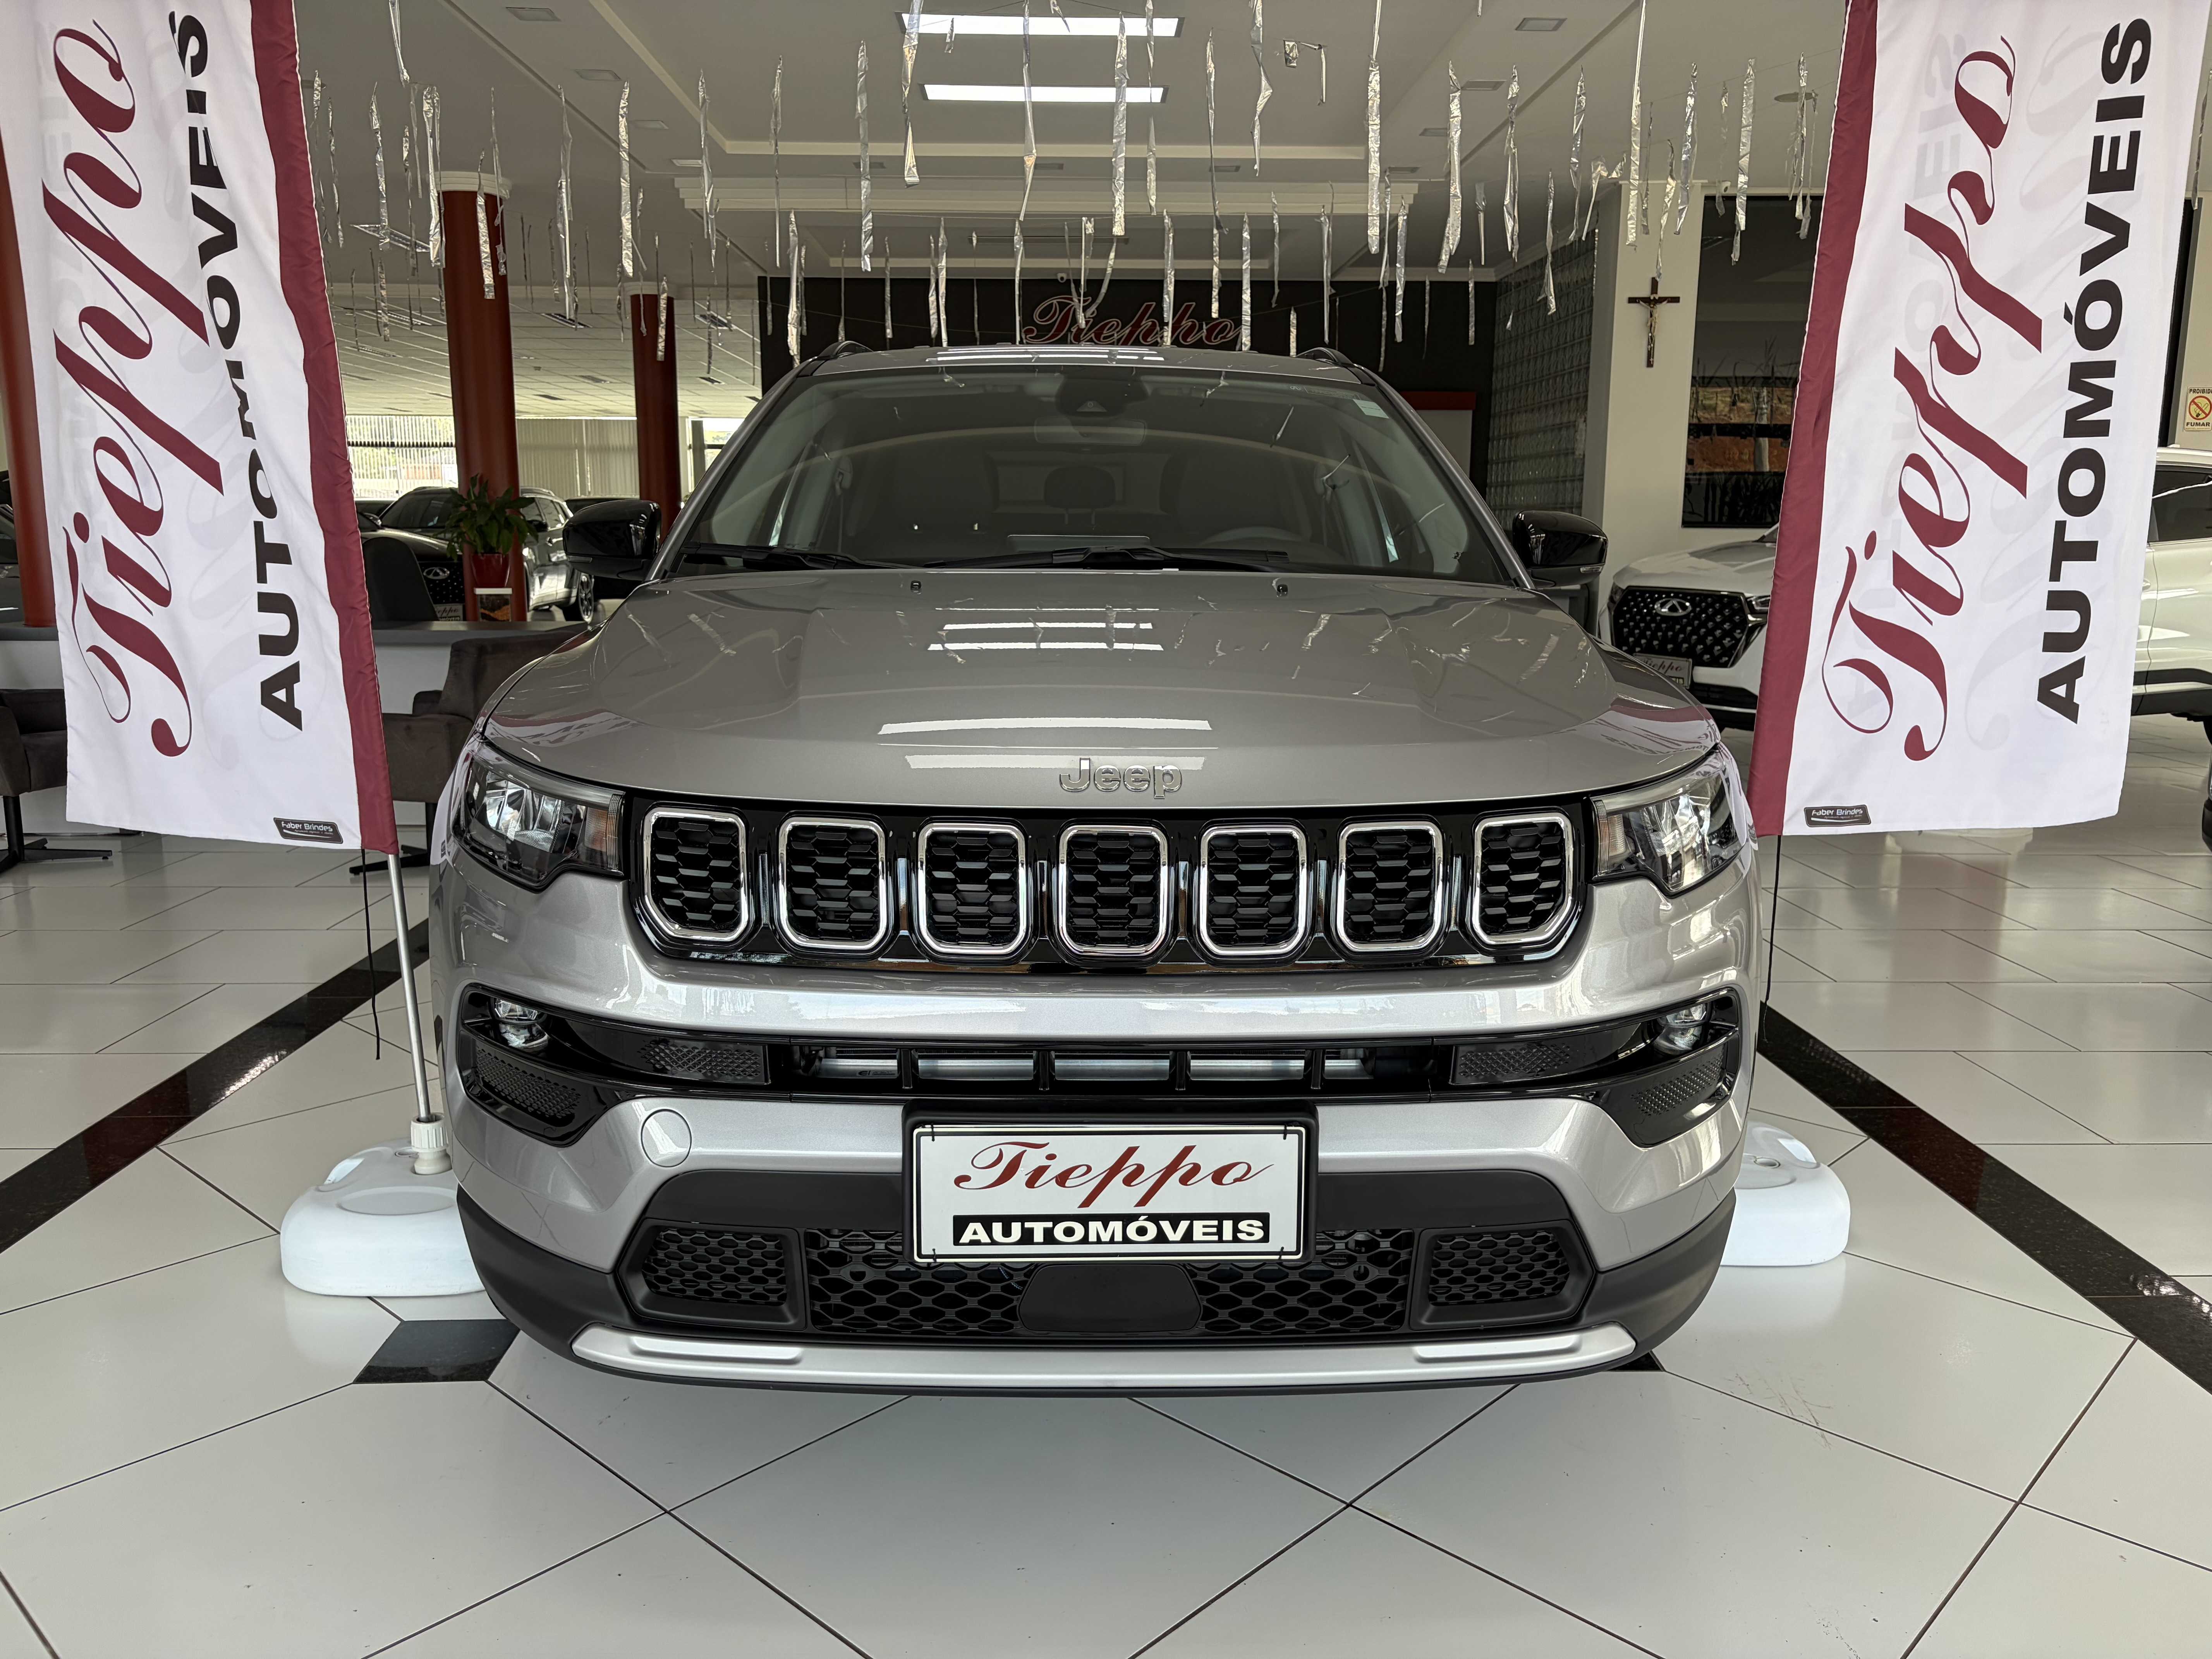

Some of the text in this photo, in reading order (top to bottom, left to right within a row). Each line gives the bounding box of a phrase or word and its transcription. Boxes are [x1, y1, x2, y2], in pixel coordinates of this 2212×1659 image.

[43, 19, 223, 757] Tieppo
[1822, 36, 2043, 761] Tieppo
[2037, 19, 2151, 724] AUTOMÓVEIS
[1059, 757, 1182, 799] Jeep
[282, 821, 333, 831] Faber Brindes
[954, 1141, 1274, 1209] Tieppo
[958, 1215, 1264, 1243] AUTOMÓVEIS
